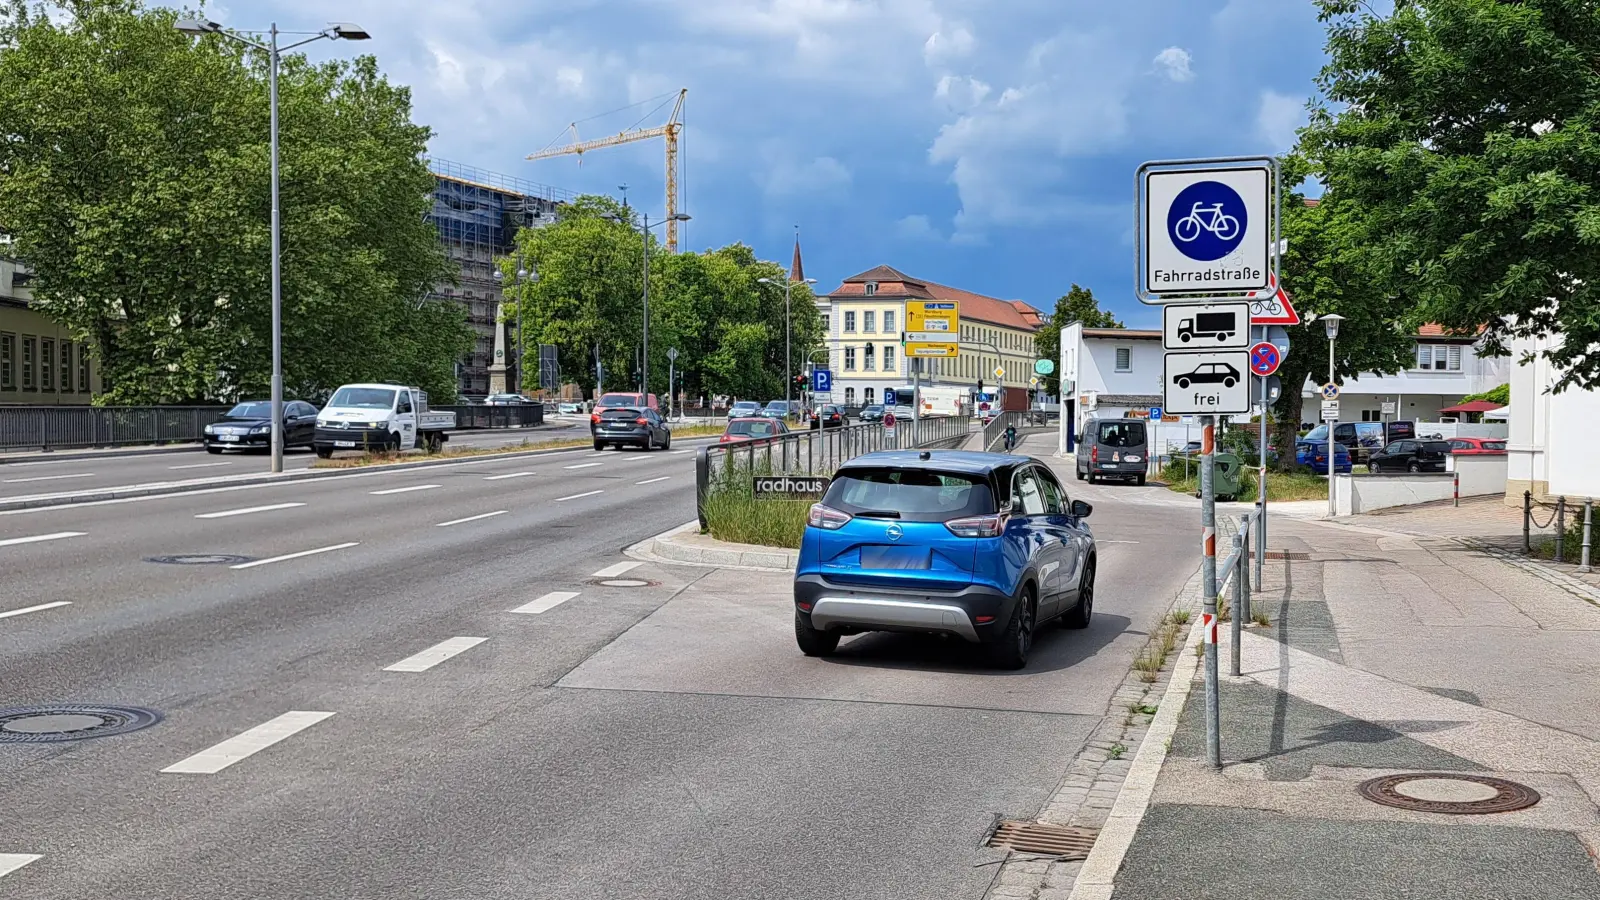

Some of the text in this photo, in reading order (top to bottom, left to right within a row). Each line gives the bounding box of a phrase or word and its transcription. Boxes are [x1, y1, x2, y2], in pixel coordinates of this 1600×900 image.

[1154, 266, 1261, 283] Fahrradstraße
[817, 372, 828, 390] P
[1193, 391, 1220, 406] frei
[1152, 408, 1159, 418] P
[756, 477, 823, 492] radhaus
